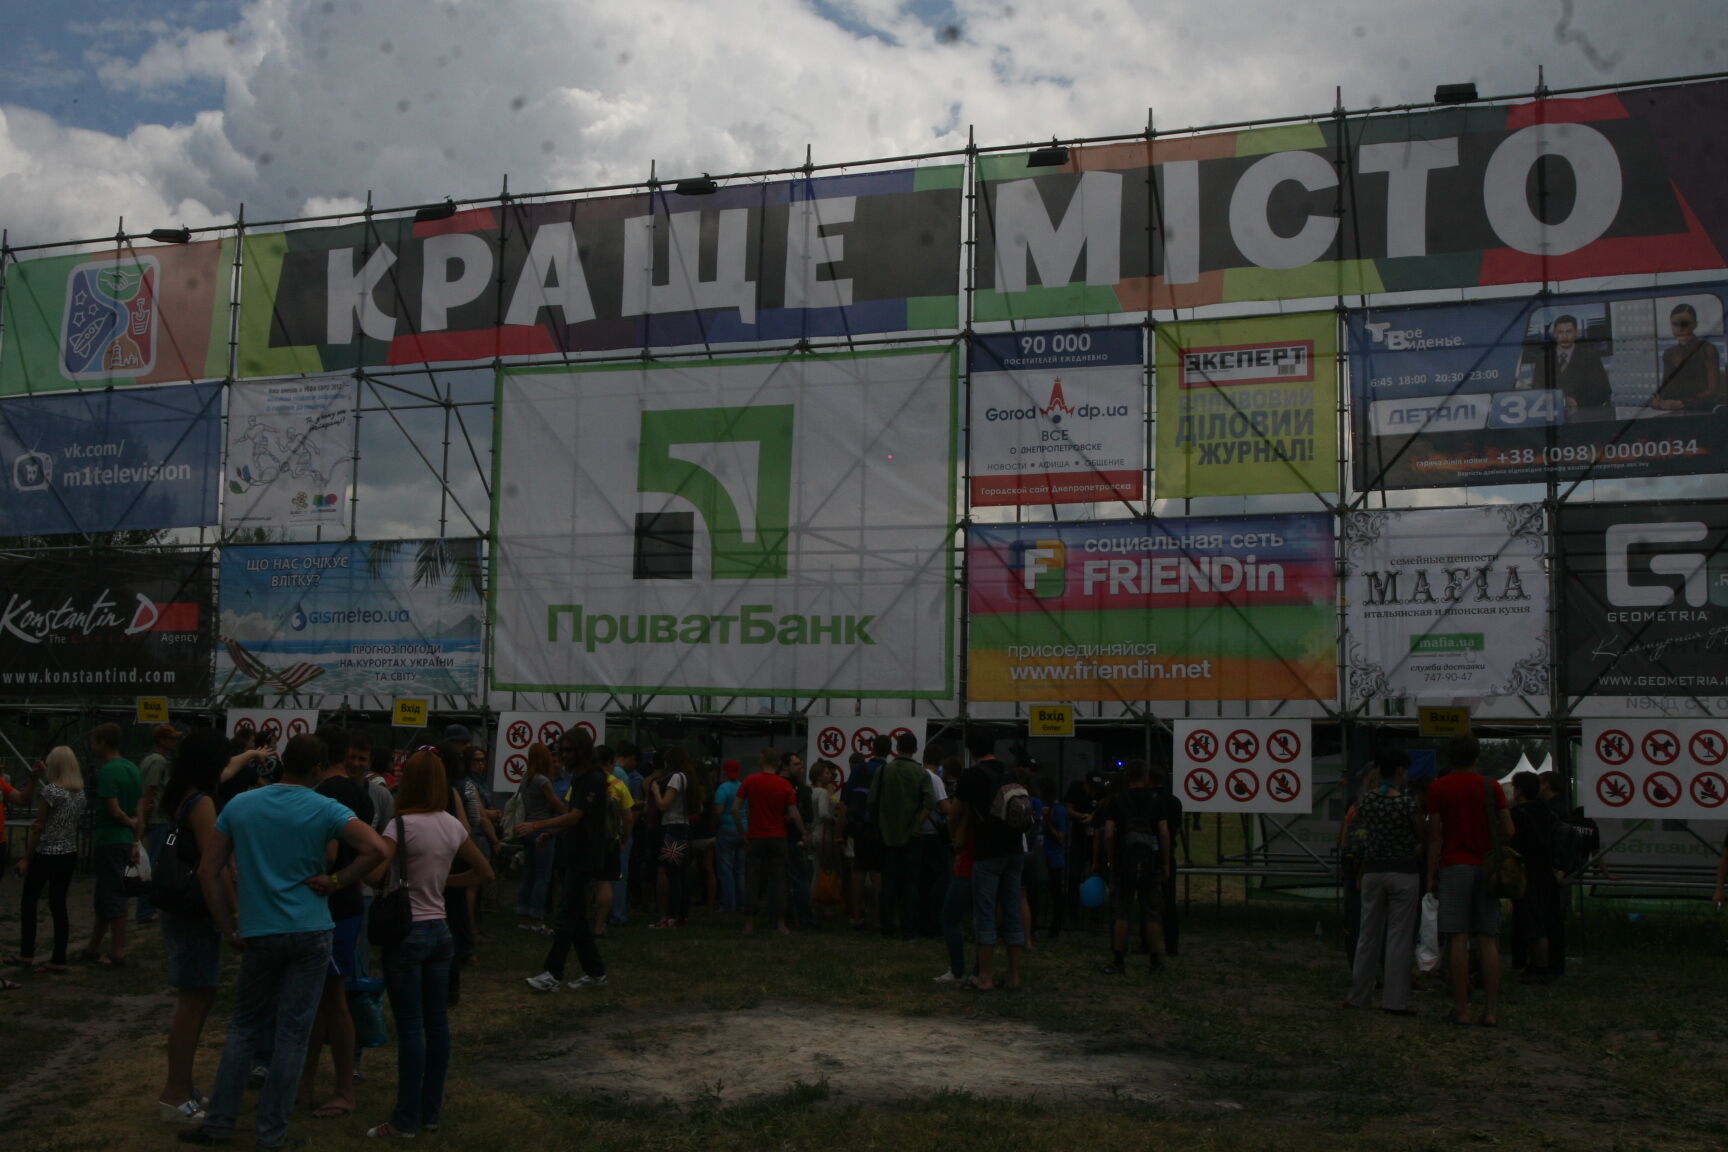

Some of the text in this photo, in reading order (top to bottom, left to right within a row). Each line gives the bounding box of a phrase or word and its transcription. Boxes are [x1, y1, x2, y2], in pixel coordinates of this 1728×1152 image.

[327, 122, 1623, 345] КРАЩЕ МІСТО
[1021, 333, 1091, 354] 90 000
[1004, 353, 1109, 366] ПОСЕТИТЕЛЕЙ ЕЖЕДНЕВНО
[1185, 347, 1305, 371] ЭКСПЕРТ
[1398, 373, 1427, 386] 18:00
[1435, 371, 1464, 384] 20:30
[1469, 368, 1499, 381] 23:00
[985, 404, 1128, 422] Gorod dp.ua
[1386, 395, 1559, 425] ДЕТАЛІ 34
[1041, 430, 1069, 441] ВСЕ
[64, 440, 125, 459] vk.com/
[1020, 443, 1103, 454] ДНЕПРОПЕТРОВСКЕ
[1198, 439, 1315, 466] ЖУРНАЛ!
[1497, 439, 1699, 466] +38 (098) 0000034
[987, 458, 1125, 471] НОВОСТИ АФИША ОБЩЕНИЕ
[63, 462, 191, 487] m1television
[981, 487, 1027, 496] Городской
[1029, 485, 1049, 494] сайт
[1084, 532, 1284, 554] социальная сеть
[247, 556, 349, 572] ЩО НАС ОЧІКУЄ
[1390, 554, 1500, 567] семейные ценности
[271, 574, 321, 587] ВЛІТКУ?
[1083, 554, 1285, 597] FRIENDin
[1362, 565, 1531, 606] MAFIA
[0, 588, 125, 644] Konstantin
[1364, 607, 1433, 619] итальянская
[1444, 606, 1497, 617] японская
[1499, 605, 1531, 616] кухня
[1607, 610, 1709, 622] GEOMETRIA
[547, 604, 876, 653] ПриватБанк
[160, 632, 199, 645] Agency
[1419, 635, 1475, 649] mafia.ua
[352, 644, 441, 655] ПРОГНОЗ ПОГОДИ
[1007, 641, 1158, 660] присоединяйся
[340, 655, 454, 668] НА КУРОРТАХ УКРАЇНИ
[2, 667, 176, 684] www.konstantind.com
[375, 672, 417, 681] ТА СВІТУ
[1009, 659, 1213, 681] www.friendin.net
[401, 703, 421, 715] Вхід
[1039, 710, 1065, 723] Вхід
[1430, 711, 1460, 723] Вхід
